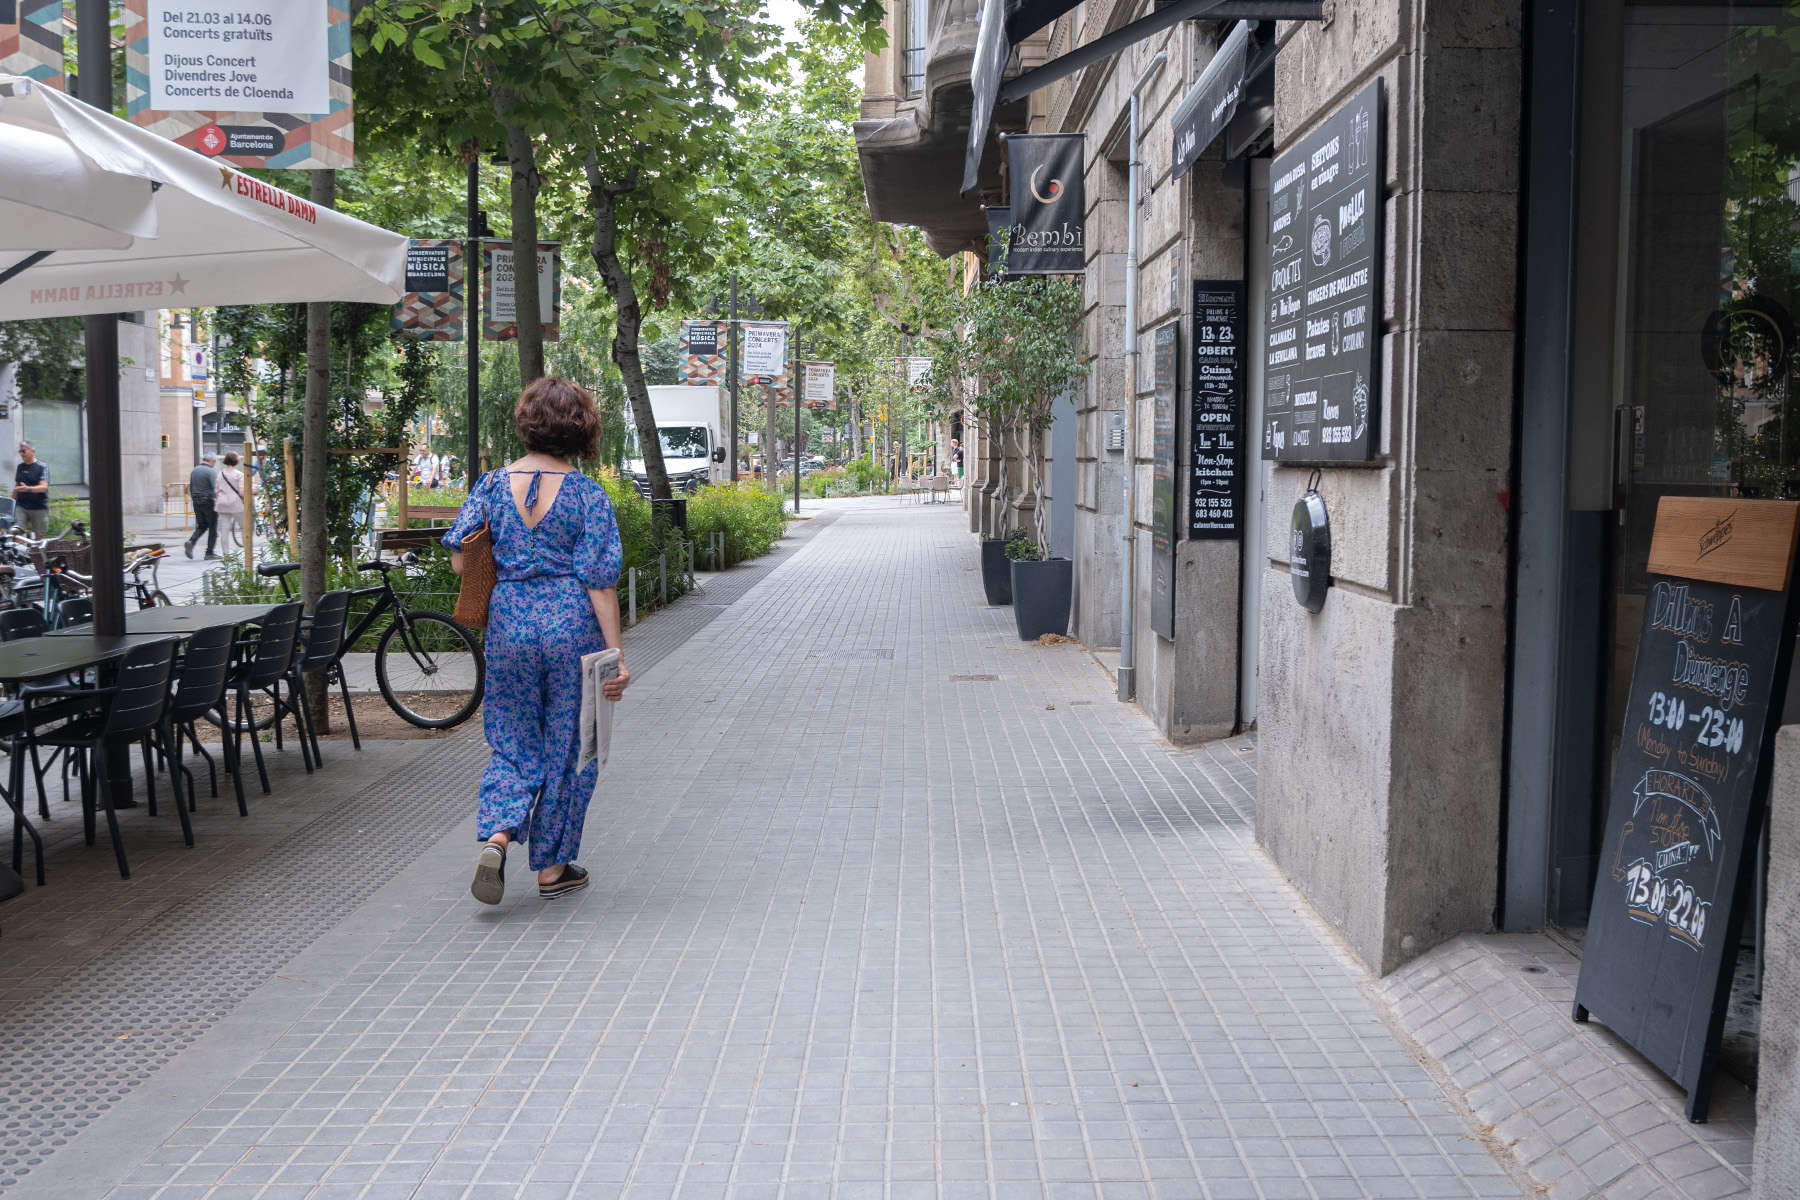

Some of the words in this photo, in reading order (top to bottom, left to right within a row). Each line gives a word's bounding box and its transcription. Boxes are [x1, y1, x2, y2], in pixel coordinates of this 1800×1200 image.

[163, 11, 183, 23] Del
[187, 12, 220, 24] 21.03
[223, 12, 234, 24] al
[237, 13, 272, 26] 14.06
[164, 26, 220, 39] Concerts
[223, 28, 273, 42] gratuïts
[164, 54, 203, 68] Dijous
[206, 55, 256, 68] Concert
[165, 70, 226, 82] Divendres
[229, 70, 257, 82] Jove
[165, 85, 221, 97] Concerts
[224, 86, 240, 97] de
[243, 86, 294, 99] Cloenda
[230, 132, 264, 142] Ajuntament
[230, 140, 274, 149] Barcelona
[1319, 162, 1339, 186] vinagre
[237, 174, 285, 211] ESTRELLA
[287, 195, 316, 224] DAMM
[1308, 284, 1328, 305] FINGERS
[1329, 281, 1336, 297] DE
[1337, 268, 1368, 294] POLLASTRE
[1306, 317, 1330, 338] Patates
[1198, 346, 1236, 355] OBERT
[1201, 365, 1232, 374] Cuina
[1200, 413, 1230, 422] OPEN
[1200, 433, 1211, 447] 1pm
[1218, 433, 1234, 447] 11pm
[1196, 454, 1234, 468] Non-Stop
[1195, 468, 1234, 476] kitchen
[1195, 498, 1206, 507] 932
[1208, 498, 1218, 507] 155
[1220, 498, 1232, 507] 523
[1195, 510, 1207, 518] 683
[1209, 510, 1221, 518] 460
[1222, 510, 1233, 518] 413
[1652, 582, 1714, 640] Dilluns
[1722, 598, 1741, 642] A
[1673, 640, 1748, 712] Diumenge
[1677, 741, 1687, 764] to
[1653, 774, 1699, 805] HORARI
